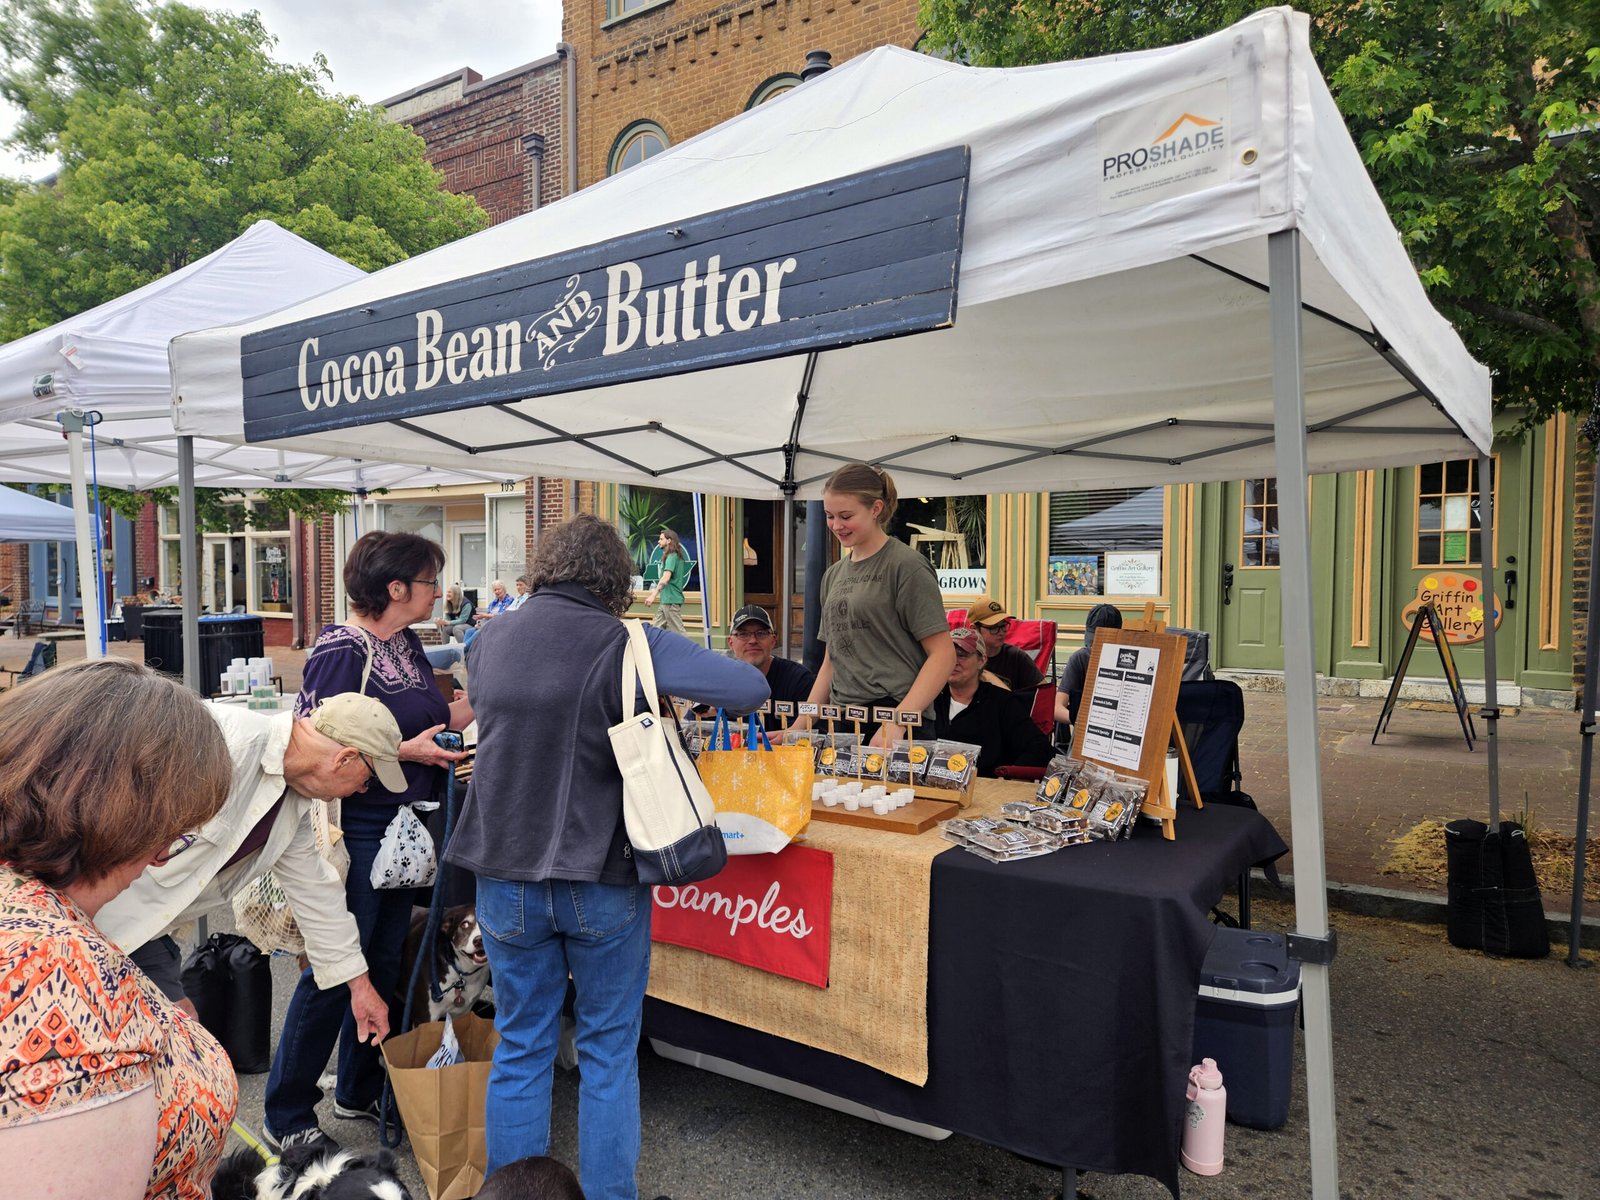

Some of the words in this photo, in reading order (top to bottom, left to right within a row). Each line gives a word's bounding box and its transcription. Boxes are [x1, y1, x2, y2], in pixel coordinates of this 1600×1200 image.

[1103, 126, 1224, 177] PROSHADE
[1103, 157, 1179, 182] PROFESSIONAL
[1180, 143, 1225, 160] QUALITY
[298, 337, 406, 412] Cocoa
[415, 309, 522, 391] Bean
[535, 290, 593, 361] AND
[602, 254, 797, 355] Butter
[1421, 590, 1474, 604] Griffin
[1421, 617, 1483, 635] Gllery
[721, 831, 745, 839] mart+
